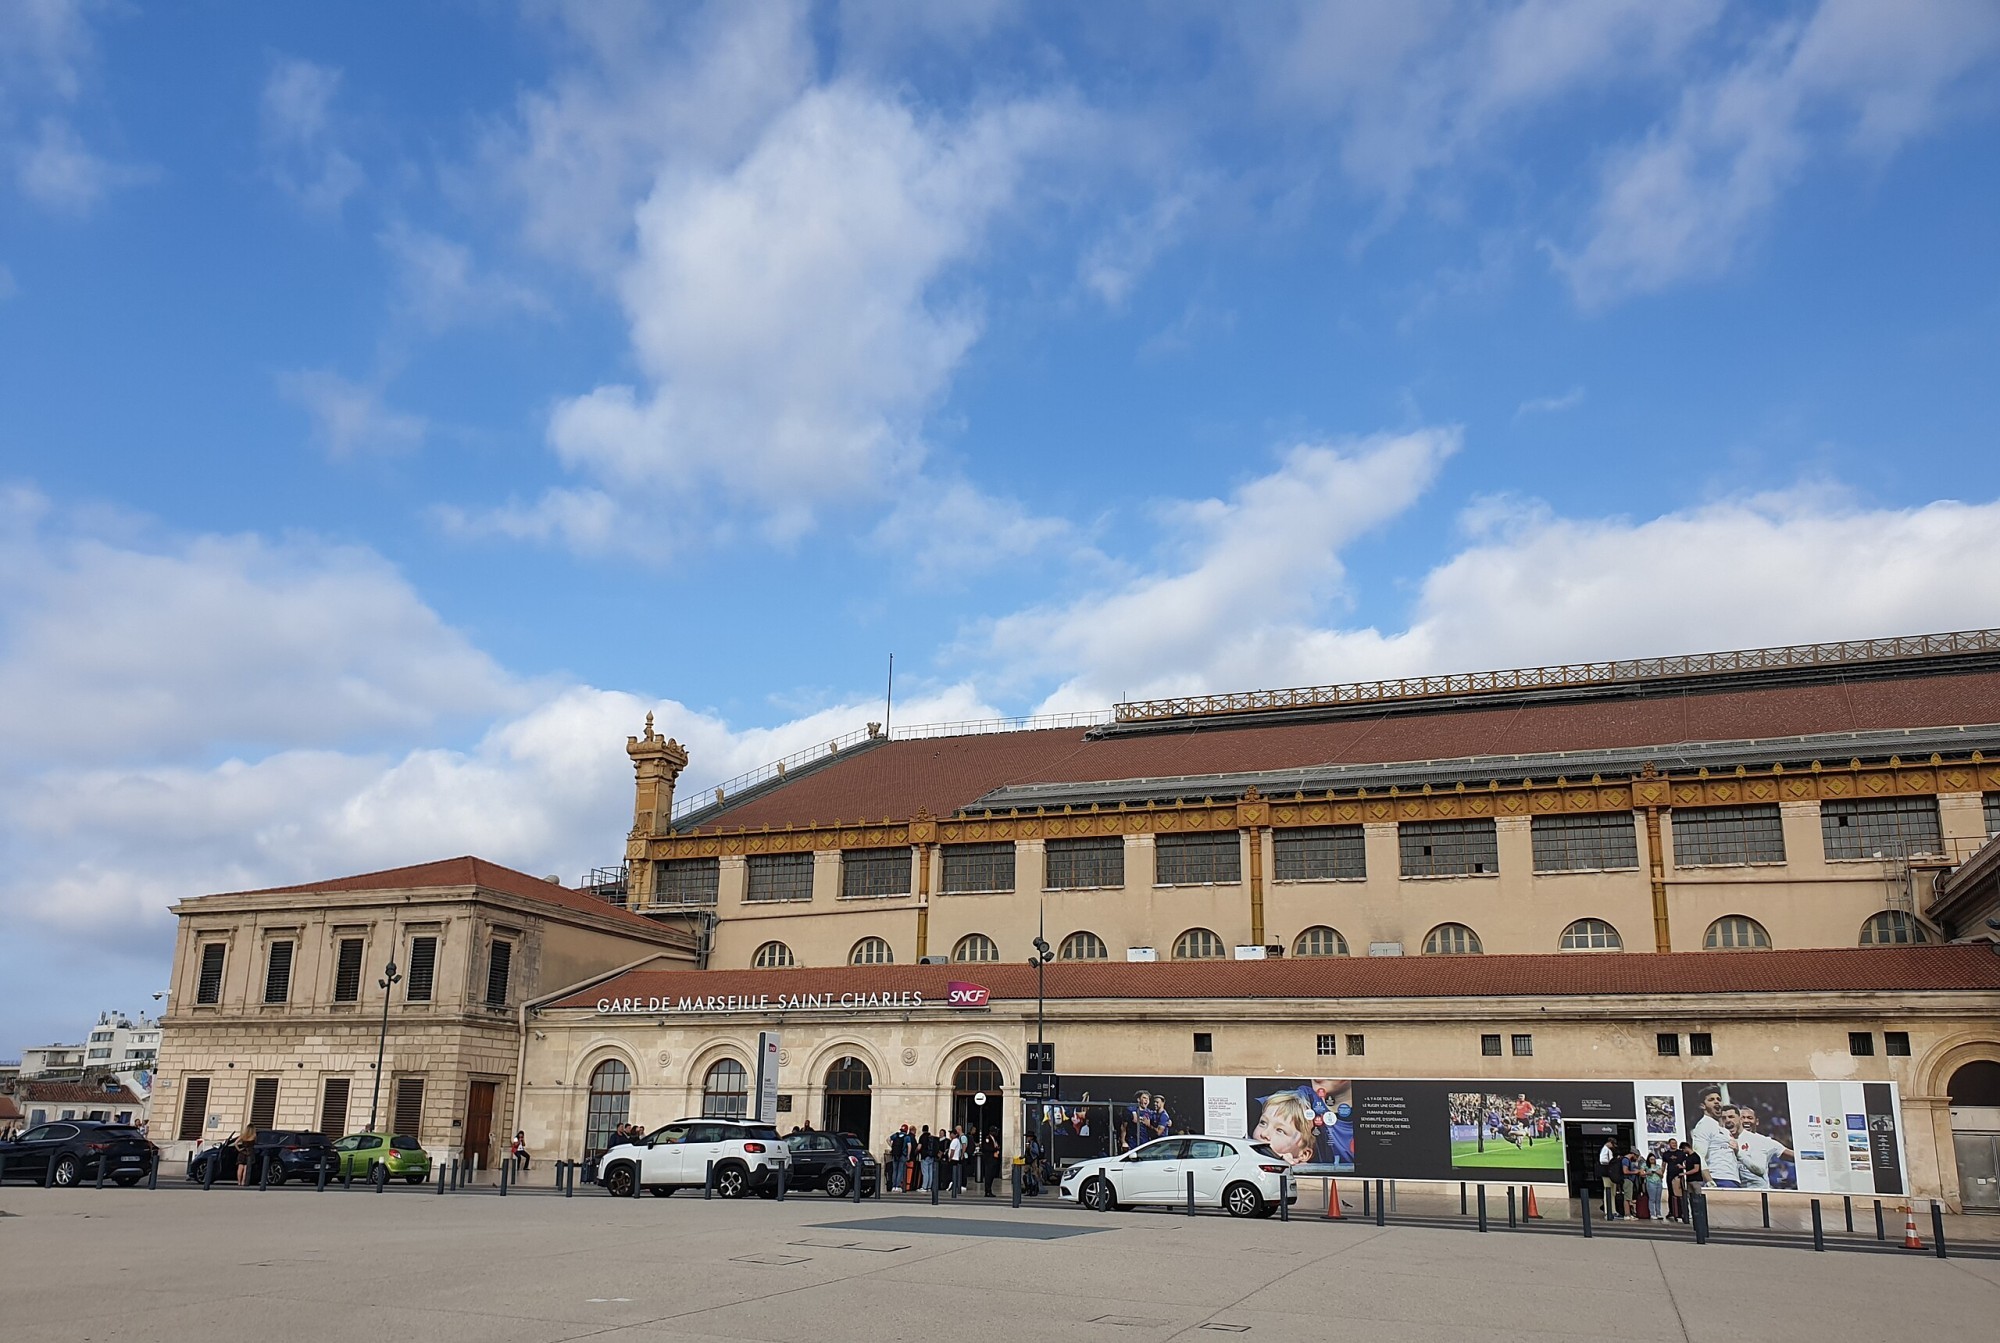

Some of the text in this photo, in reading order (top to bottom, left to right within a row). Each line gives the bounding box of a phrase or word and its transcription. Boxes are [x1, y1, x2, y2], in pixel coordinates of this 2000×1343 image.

[597, 991, 922, 1012] GARE DE MARSEILLE SAINT CHARLES
[949, 990, 986, 1002] SNCF
